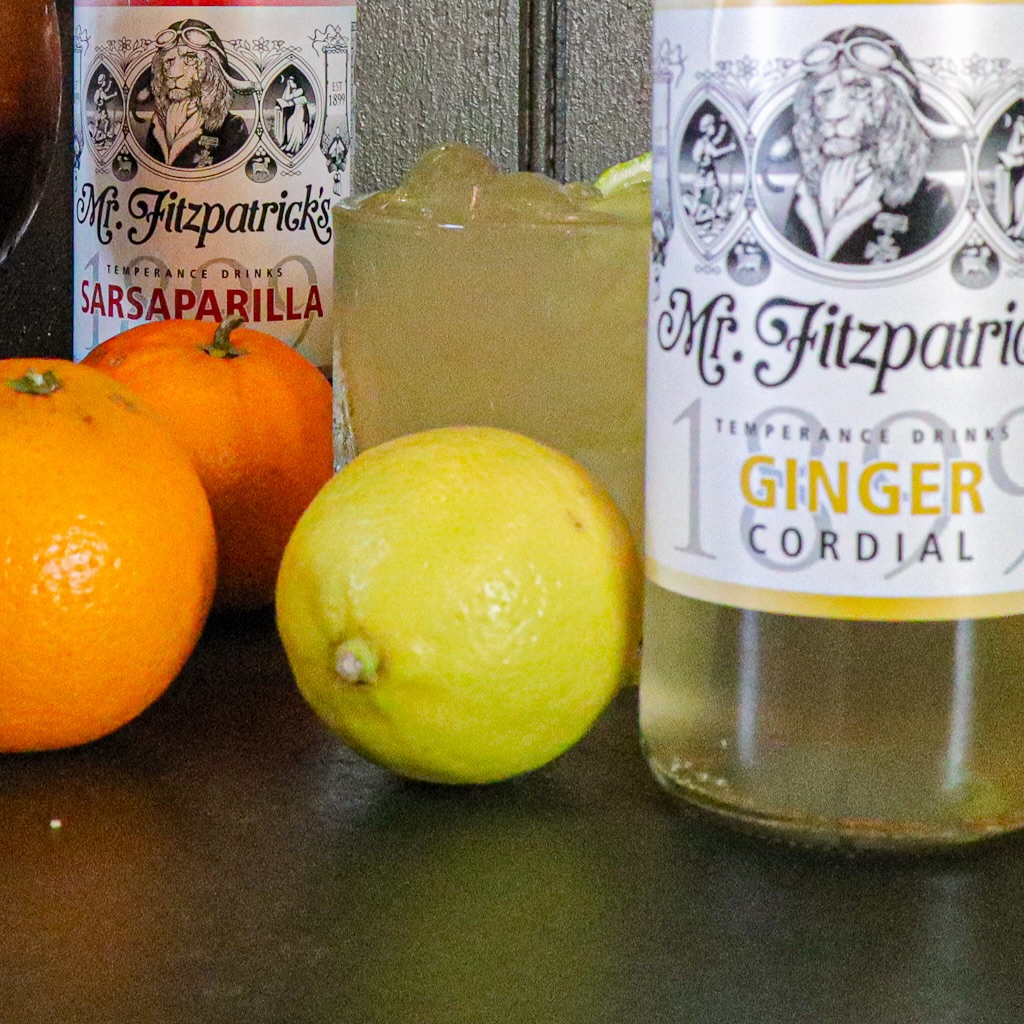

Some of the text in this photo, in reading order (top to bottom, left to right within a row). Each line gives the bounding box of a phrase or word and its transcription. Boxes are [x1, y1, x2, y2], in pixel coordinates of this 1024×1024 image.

[328, 93, 346, 107] 1899
[332, 81, 343, 92] EST
[77, 183, 333, 249] Mr. Fitzpatrick's
[106, 264, 284, 279] TEMPERANCE DRINKS
[81, 279, 324, 323] SARSAPARILLA
[657, 288, 743, 387] Mr.
[714, 418, 1010, 445] TEMPERANCE DRINKS
[739, 454, 985, 516] GINGER
[748, 524, 974, 563] CORDIAL
